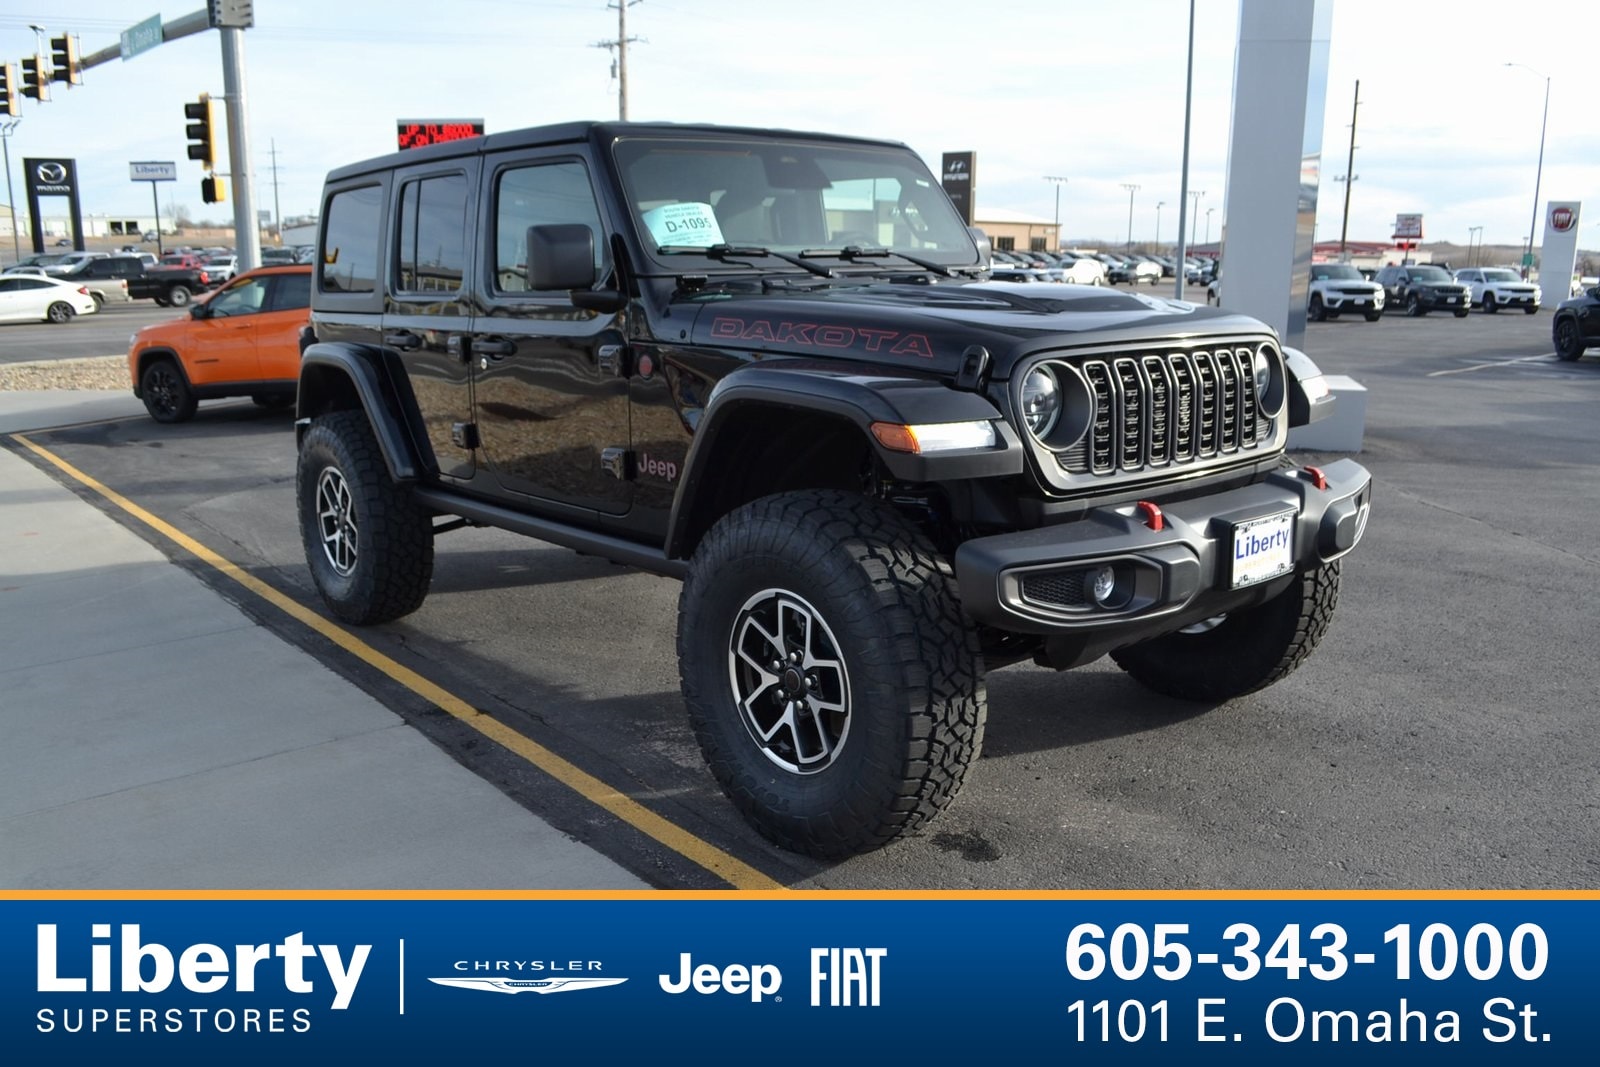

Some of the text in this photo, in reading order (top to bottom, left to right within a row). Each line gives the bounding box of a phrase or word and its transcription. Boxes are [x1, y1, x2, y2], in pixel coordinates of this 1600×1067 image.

[135, 165, 170, 174] Liberty
[665, 217, 713, 233] D-1095
[711, 317, 934, 359] DAKOTA
[637, 453, 678, 482] Jeep
[1235, 528, 1290, 560] Liberty
